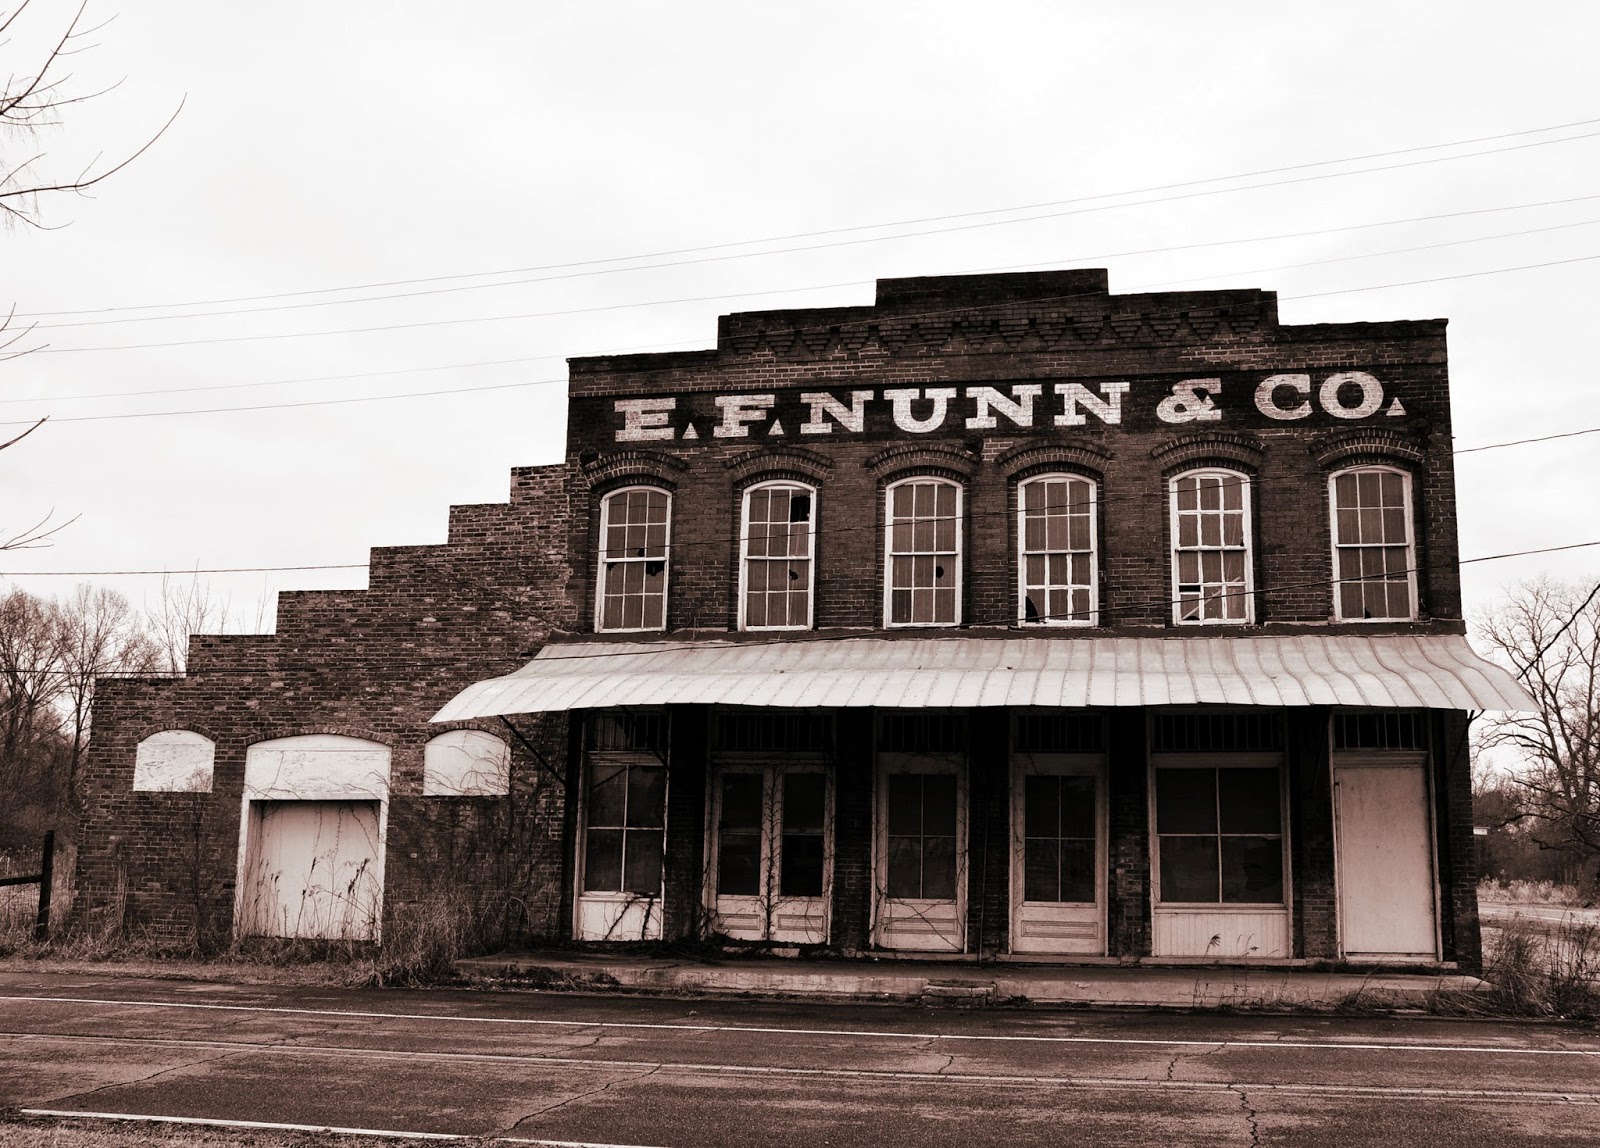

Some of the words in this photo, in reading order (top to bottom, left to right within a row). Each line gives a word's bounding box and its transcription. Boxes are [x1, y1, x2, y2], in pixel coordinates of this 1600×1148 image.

[800, 381, 1131, 434] NUNN
[1156, 377, 1223, 424] &
[1254, 371, 1407, 420] CO.
